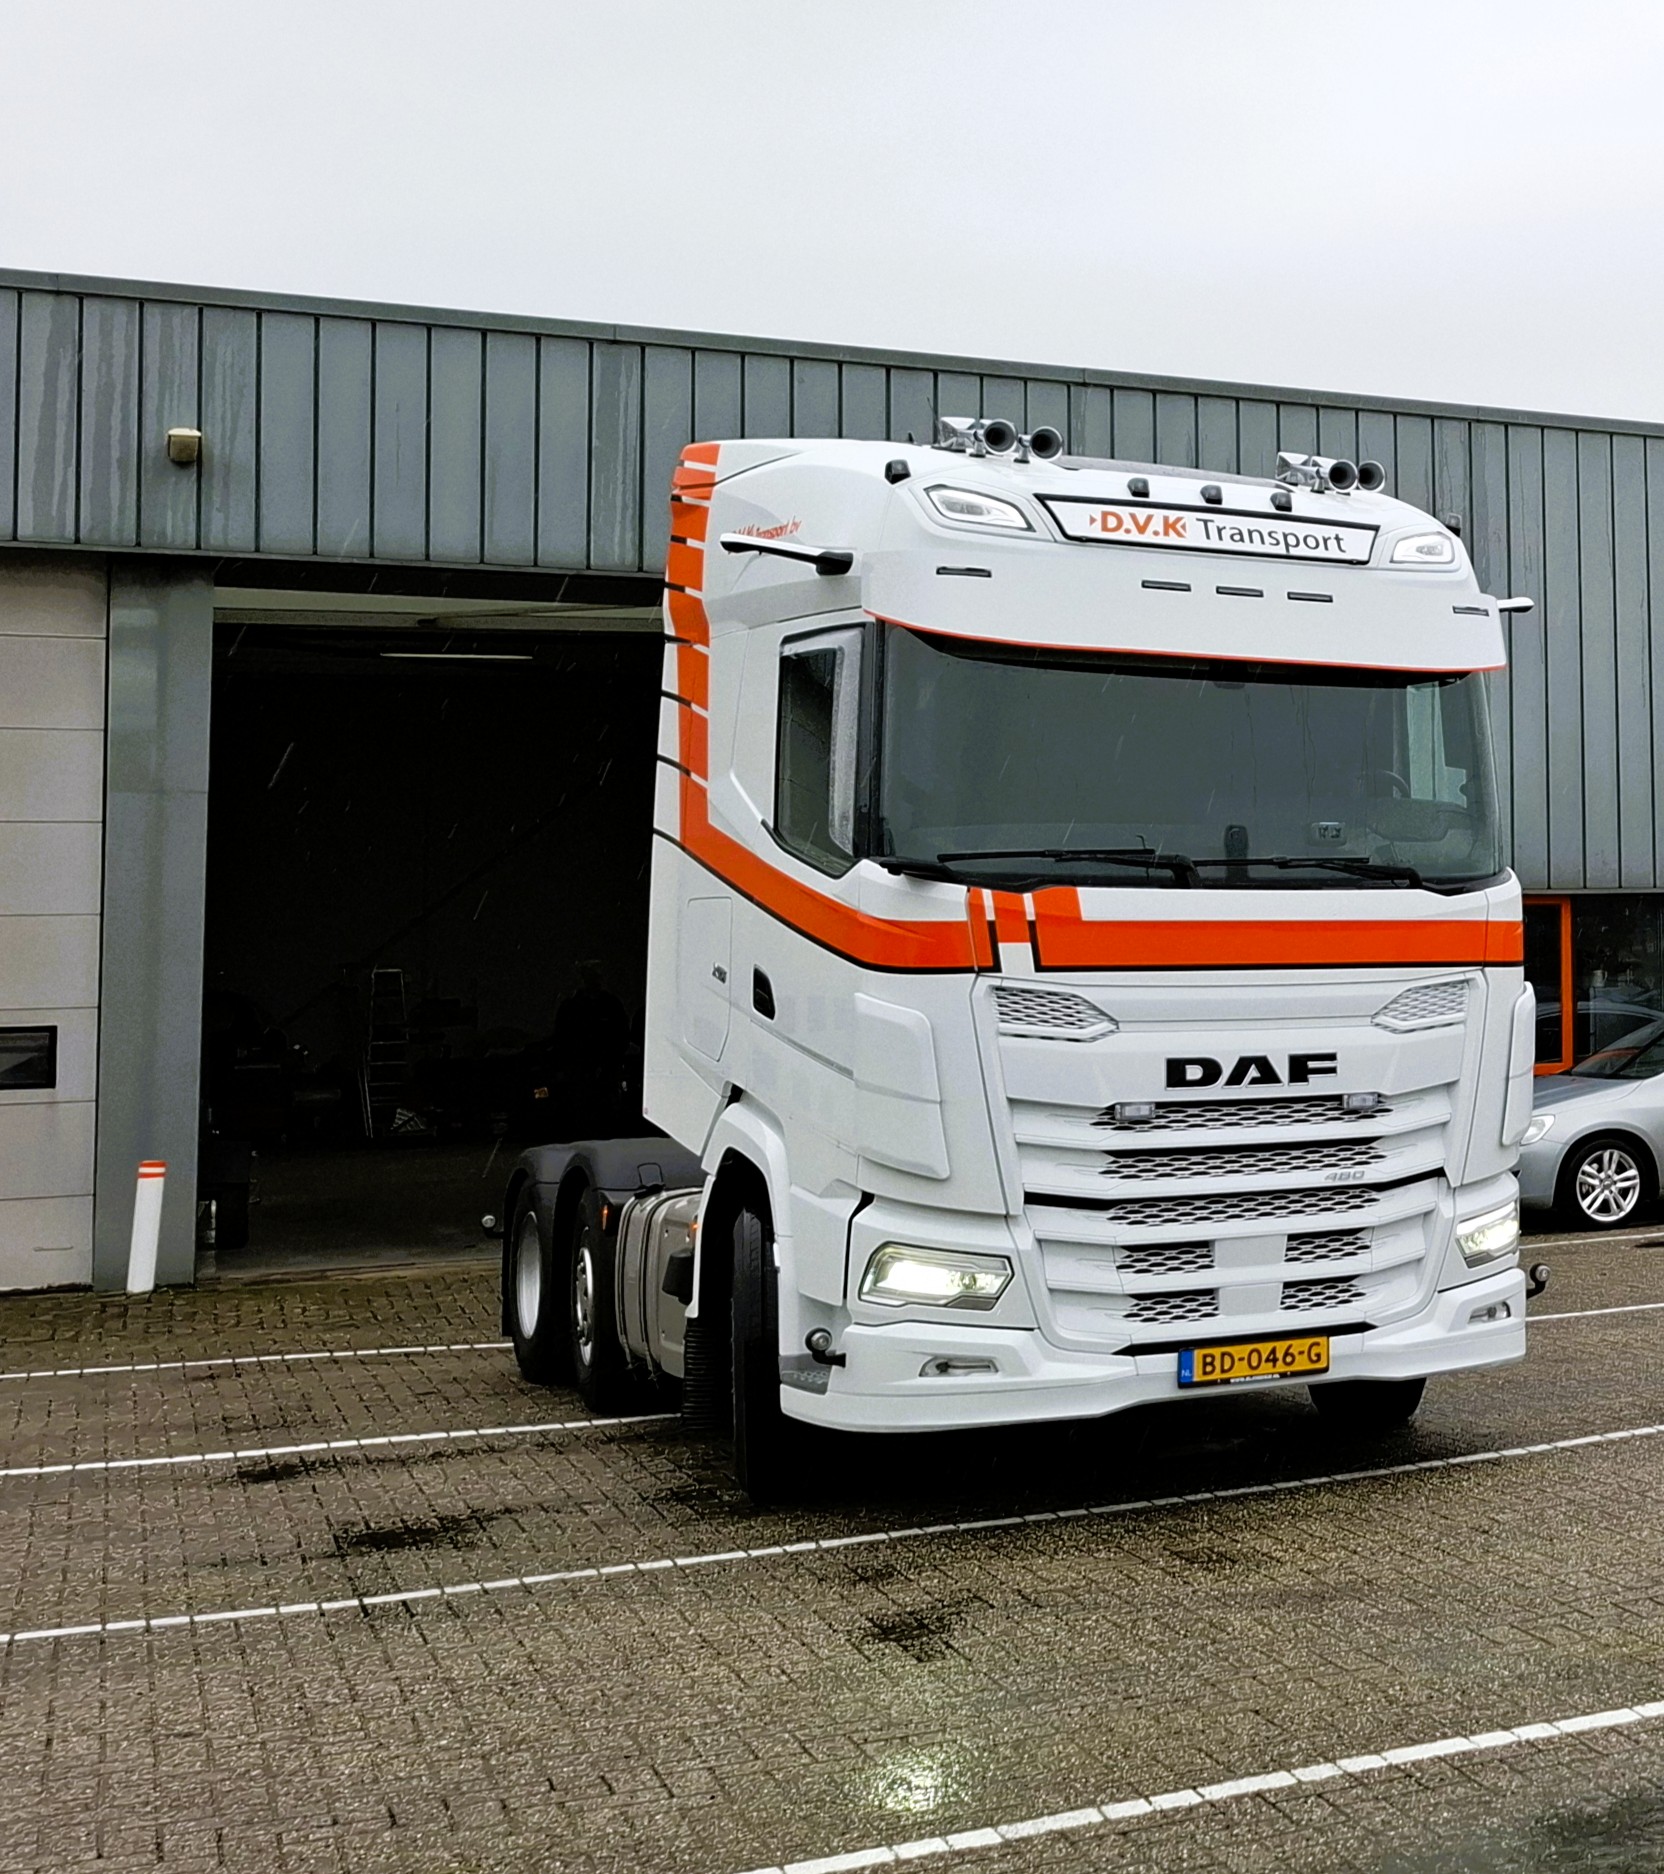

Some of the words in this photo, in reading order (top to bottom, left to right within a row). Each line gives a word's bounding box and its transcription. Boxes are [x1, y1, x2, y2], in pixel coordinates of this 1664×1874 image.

[1196, 517, 1347, 554] Transport
[1164, 1052, 1338, 1092] DAF
[1181, 1369, 1193, 1378] NL
[1201, 1341, 1322, 1376] BD-046-G
